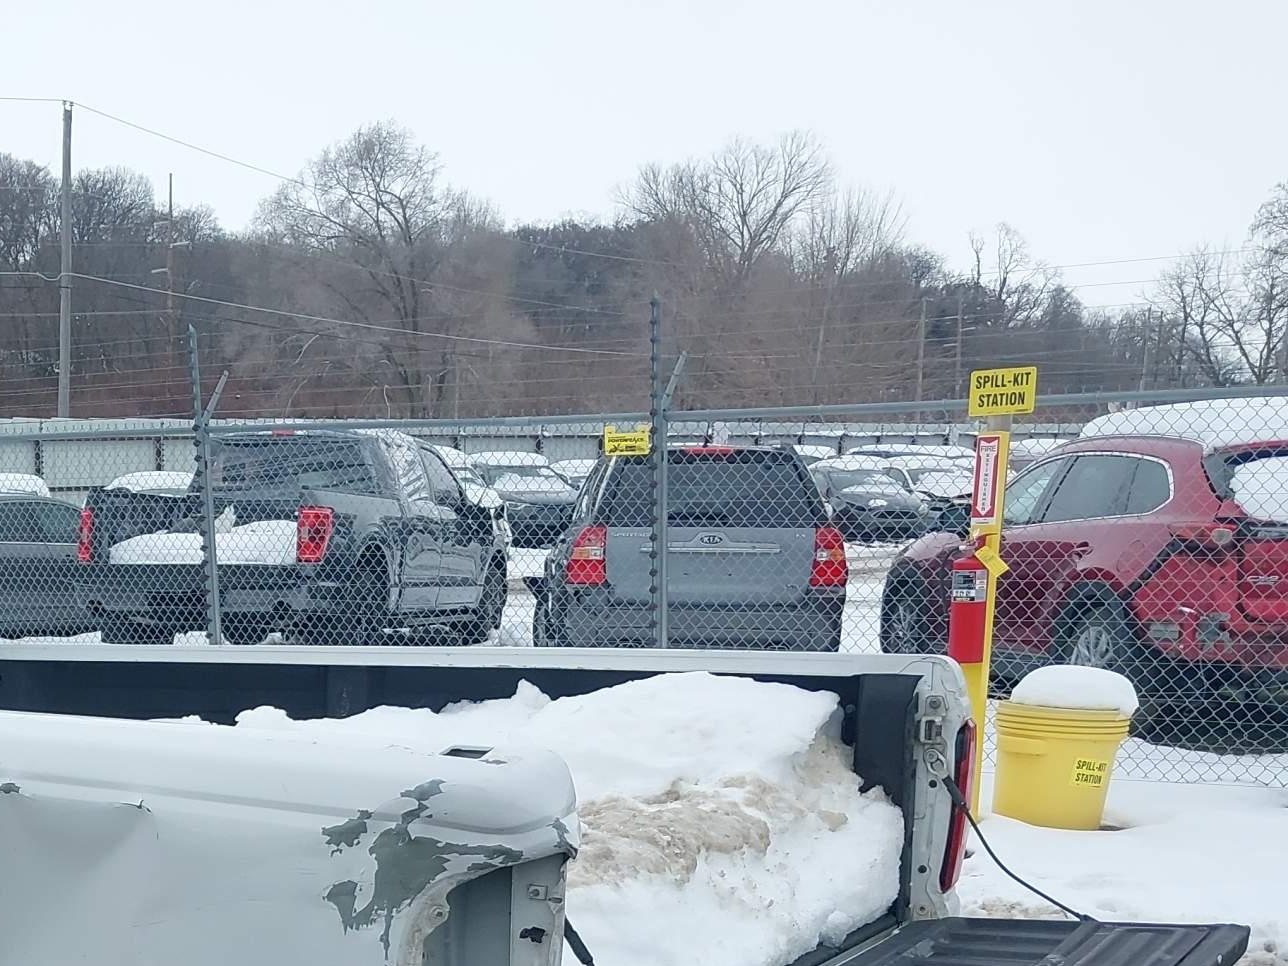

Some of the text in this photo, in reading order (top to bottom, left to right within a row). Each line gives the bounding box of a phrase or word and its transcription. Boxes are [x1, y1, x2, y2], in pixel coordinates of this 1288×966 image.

[975, 371, 1032, 390] SPILL-KIT
[977, 391, 1026, 408] STATION
[702, 535, 721, 544] KIA
[1075, 759, 1108, 772] SPILL-KIT
[1075, 772, 1103, 785] STATION
